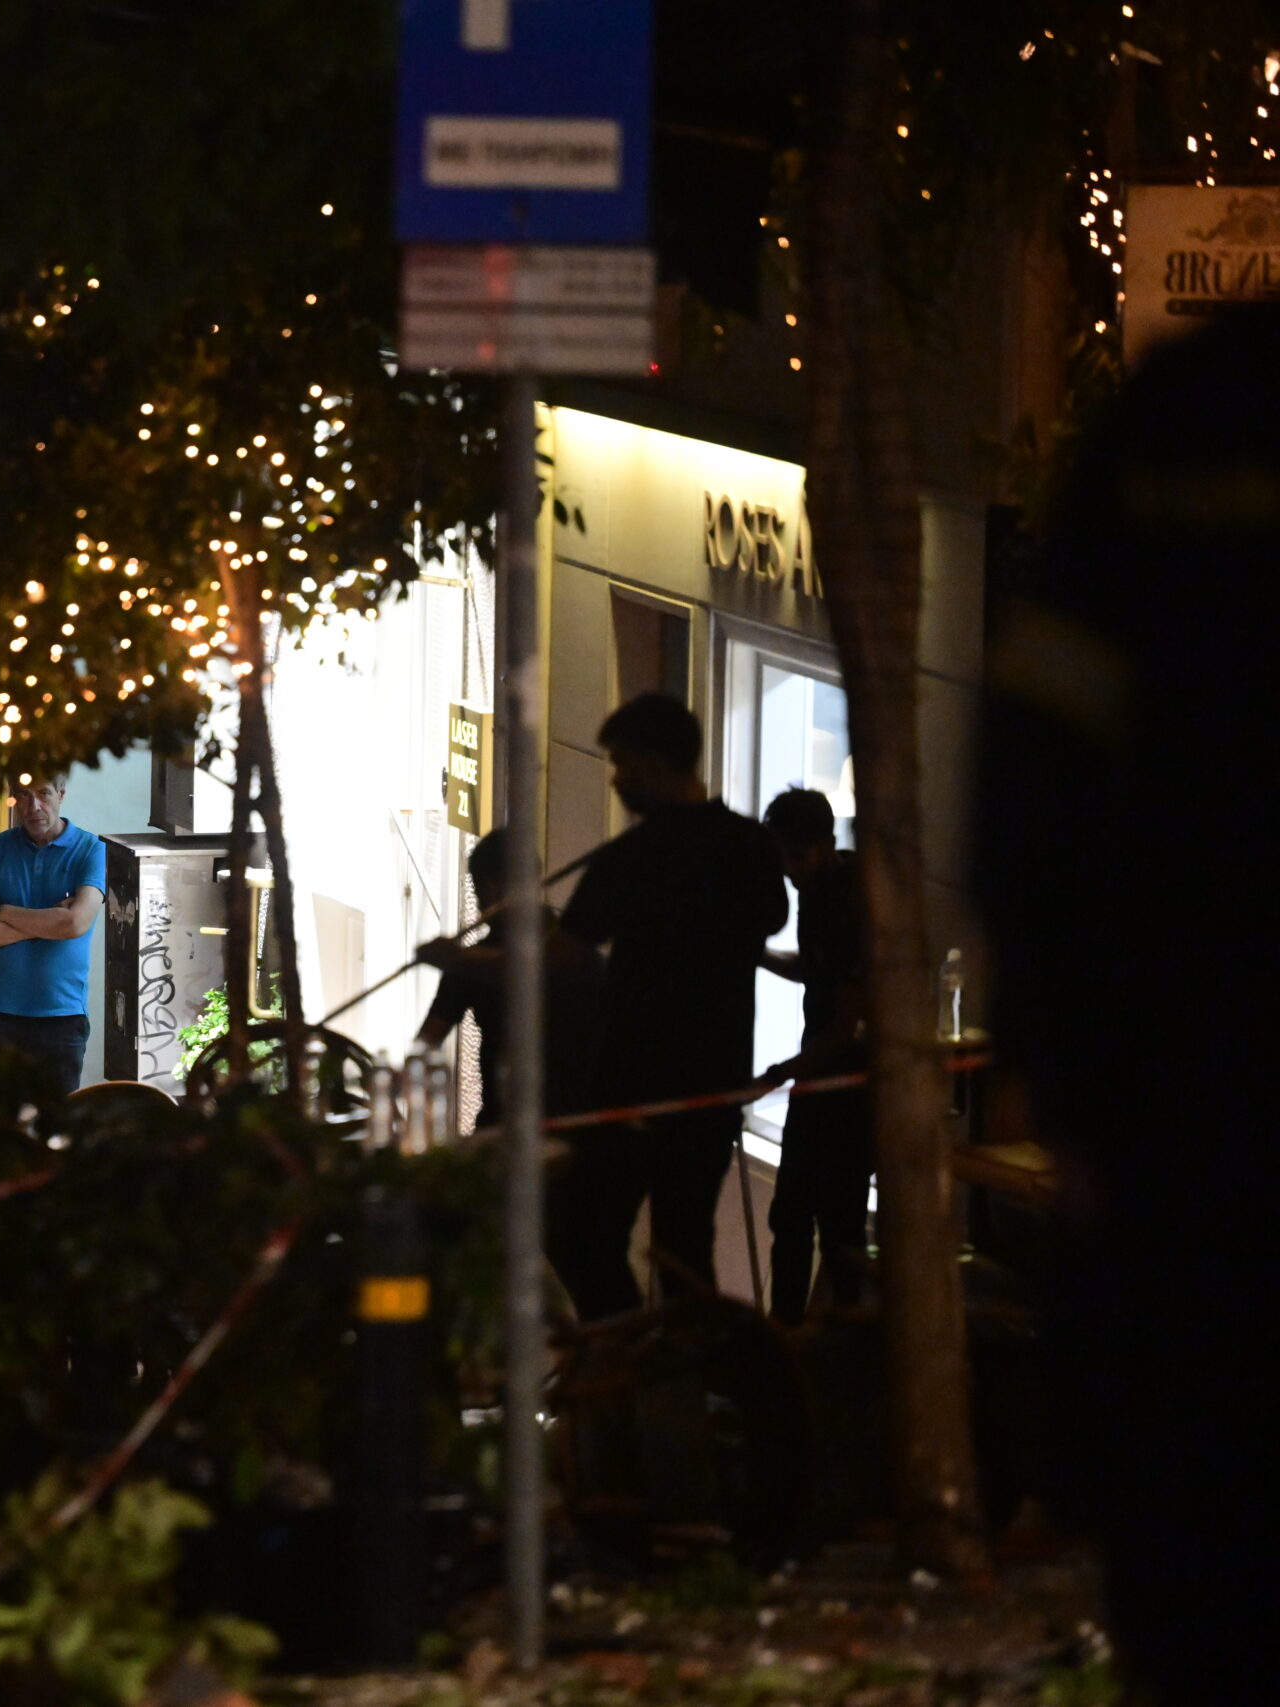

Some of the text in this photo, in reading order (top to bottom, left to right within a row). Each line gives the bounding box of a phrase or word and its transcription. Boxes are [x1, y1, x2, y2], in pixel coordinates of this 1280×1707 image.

[704, 490, 786, 583] ROSES
[451, 717, 478, 750] LASER
[451, 752, 478, 786] HOUSE
[457, 789, 469, 818] 21
